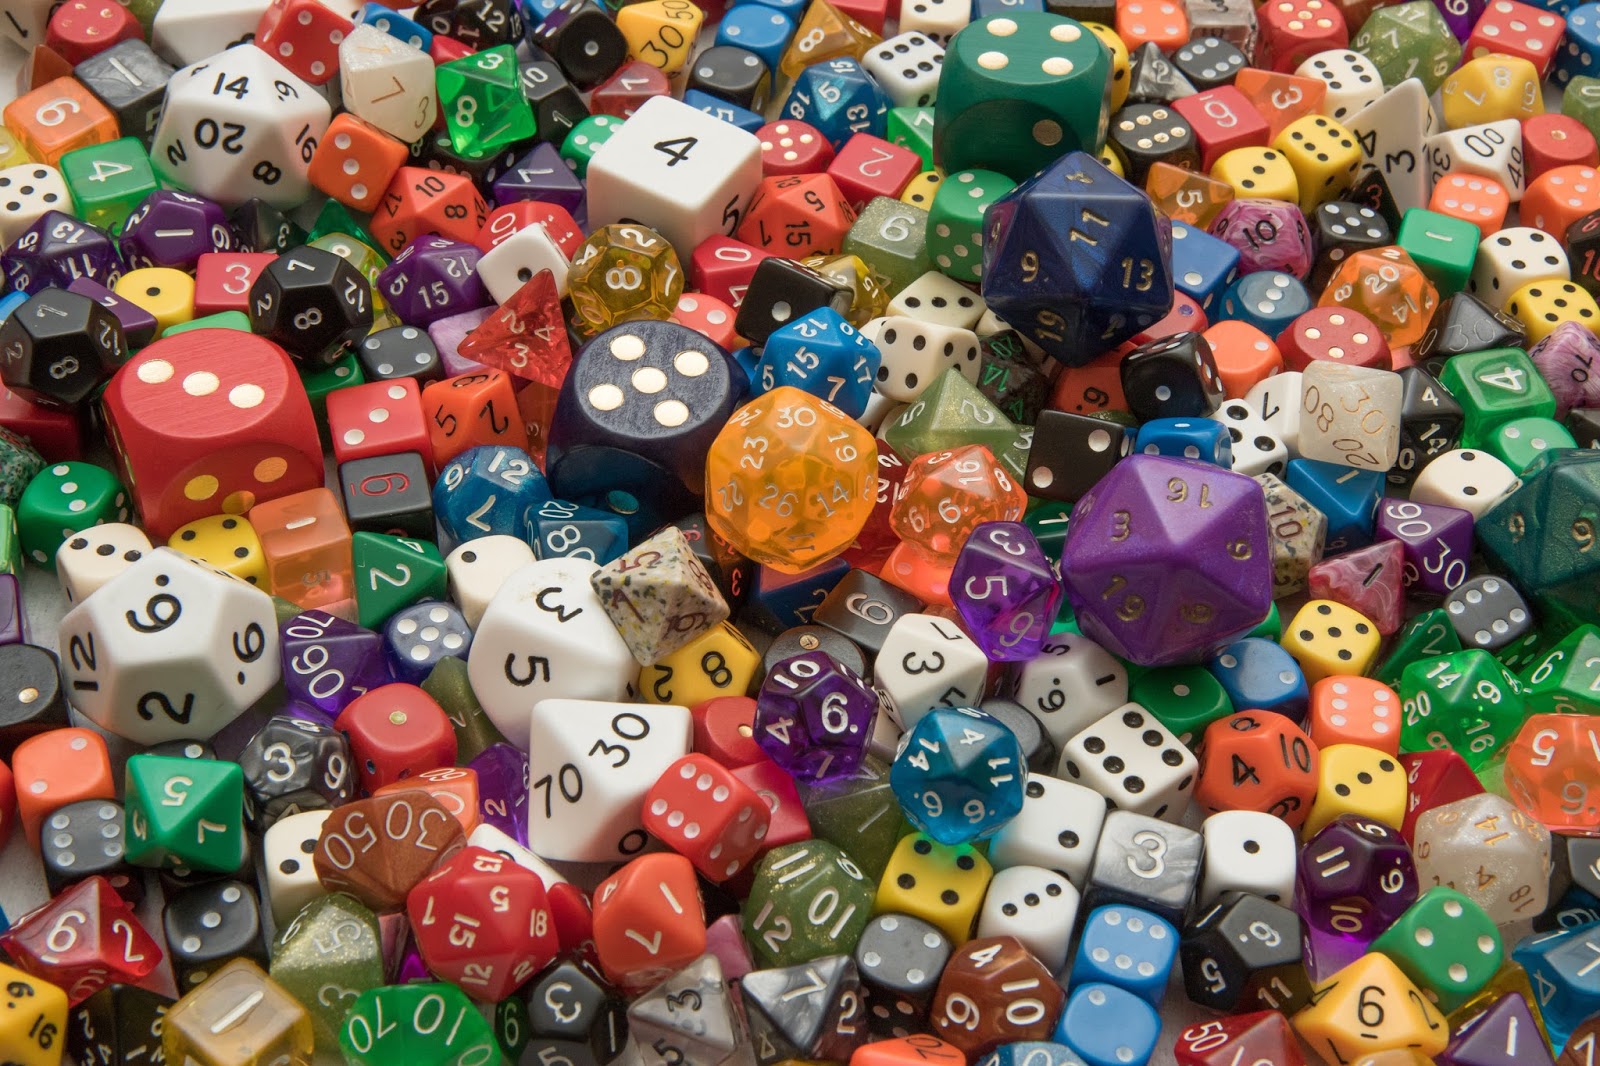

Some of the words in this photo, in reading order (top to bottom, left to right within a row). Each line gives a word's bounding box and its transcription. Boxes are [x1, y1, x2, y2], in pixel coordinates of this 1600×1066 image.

[477, 0, 505, 32] 12
[640, 25, 684, 68] 30
[799, 28, 825, 52] 8
[477, 53, 505, 70] 3
[213, 72, 249, 99] 14
[524, 67, 548, 88] 10
[818, 81, 841, 103] 5
[1492, 66, 1512, 88] 8
[456, 95, 477, 127] 8
[1272, 85, 1303, 109] 3
[1464, 90, 1487, 106] 7
[847, 103, 868, 133] 13
[194, 118, 246, 154] 20
[1354, 128, 1377, 158] 4
[1464, 127, 1505, 158] 00
[167, 139, 187, 166] 2
[654, 137, 698, 166] 4
[858, 147, 894, 177] 2
[1386, 150, 1415, 173] 3
[89, 160, 133, 182] 4
[253, 160, 281, 185] 8
[1508, 146, 1522, 189] 40
[416, 176, 446, 197] 10
[804, 190, 825, 212] 5
[1176, 189, 1203, 207] 5
[1367, 184, 1383, 211] 3
[445, 204, 468, 221] 8
[1069, 208, 1110, 246] 11
[52, 222, 84, 244] 13
[390, 231, 407, 250] 3
[619, 228, 656, 247] 2
[785, 223, 811, 246] 15
[1242, 219, 1277, 250] 10
[68, 254, 96, 279] 11
[443, 257, 473, 277] 12
[576, 243, 598, 266] 4
[9, 262, 29, 291] 18
[223, 264, 251, 294] 3
[390, 273, 409, 296] 5
[606, 266, 642, 290] 8
[1121, 257, 1154, 291] 13
[1364, 264, 1399, 295] 20
[257, 293, 273, 316] 2
[344, 277, 365, 313] 12
[418, 281, 449, 309] 15
[1333, 284, 1353, 301] 8
[294, 307, 322, 330] 8
[501, 310, 526, 334] 2
[1392, 293, 1418, 324] 14
[793, 317, 828, 338] 12
[839, 320, 864, 347] 10
[1448, 319, 1496, 352] 30
[50, 356, 79, 379] 8
[510, 343, 530, 368] 3
[789, 345, 820, 379] 15
[853, 353, 872, 384] 17
[762, 365, 775, 391] 5
[827, 375, 846, 402] 7
[982, 361, 1010, 393] 14
[1480, 366, 1523, 391] 4
[1422, 386, 1439, 407] 4
[435, 404, 457, 437] 5
[777, 407, 817, 428] 30
[960, 400, 994, 424] 2
[741, 436, 769, 469] 23
[1332, 438, 1380, 466] 20
[1420, 423, 1447, 455] 14
[488, 451, 529, 484] 12
[994, 468, 1011, 491] 8
[466, 495, 496, 531] 7
[759, 483, 799, 517] 26
[817, 479, 849, 517] 14
[1111, 510, 1131, 542] 3
[1270, 506, 1302, 539] 10
[397, 539, 424, 553] 4
[990, 530, 1026, 555] 3
[370, 564, 411, 590] 2
[1363, 563, 1384, 588] 1
[1424, 538, 1466, 590] 30
[965, 576, 1008, 599] 5
[536, 587, 583, 622] 3
[287, 616, 335, 638] 70
[1422, 624, 1447, 654] 2
[70, 632, 98, 691] 12
[292, 645, 345, 698] 90
[504, 653, 550, 687] 5
[701, 651, 733, 688] 8
[774, 660, 820, 689] 10
[902, 651, 945, 674] 3
[1426, 662, 1461, 688] 14
[653, 664, 673, 702] 2
[137, 691, 195, 724] 2
[1404, 691, 1432, 726] 20
[588, 713, 650, 768] 30
[766, 717, 793, 745] 4
[960, 728, 985, 745] 4
[265, 743, 296, 781] 3
[908, 738, 940, 771] 14
[1280, 733, 1311, 773] 10
[1531, 729, 1559, 766] 5
[988, 756, 1013, 787] 11
[1232, 754, 1260, 785] 4
[161, 776, 193, 806] 5
[534, 763, 582, 818] 70
[485, 799, 506, 817] 2
[198, 819, 226, 843] 7
[324, 811, 377, 869] 50
[386, 801, 447, 850] 30
[1474, 816, 1509, 845] 14
[473, 855, 502, 872] 13
[771, 850, 815, 884] 11
[1127, 831, 1168, 879] 3
[1316, 846, 1350, 877] 11
[1477, 865, 1496, 891] 4
[490, 886, 509, 912] 5
[660, 882, 682, 914] 1
[808, 887, 856, 939] 10
[1508, 885, 1534, 912] 18
[449, 913, 481, 948] 15
[530, 909, 547, 937] 18
[753, 900, 792, 953] 12
[1330, 905, 1362, 933] 10
[112, 919, 144, 962] 2
[314, 920, 362, 954] 5
[625, 929, 662, 955] 7
[970, 944, 1003, 968] 4
[461, 964, 493, 986] 12
[783, 968, 826, 1002] 7
[1533, 970, 1556, 1006] 4
[546, 982, 582, 1023] 3
[666, 990, 702, 1012] 3
[1002, 978, 1045, 1025] 10
[1258, 977, 1293, 1007] 11
[211, 990, 263, 1033] 1
[349, 996, 397, 1053] 70
[413, 994, 467, 1046] 10
[837, 991, 857, 1034] 2
[1409, 989, 1439, 1030] 2
[1184, 1021, 1228, 1052] 50
